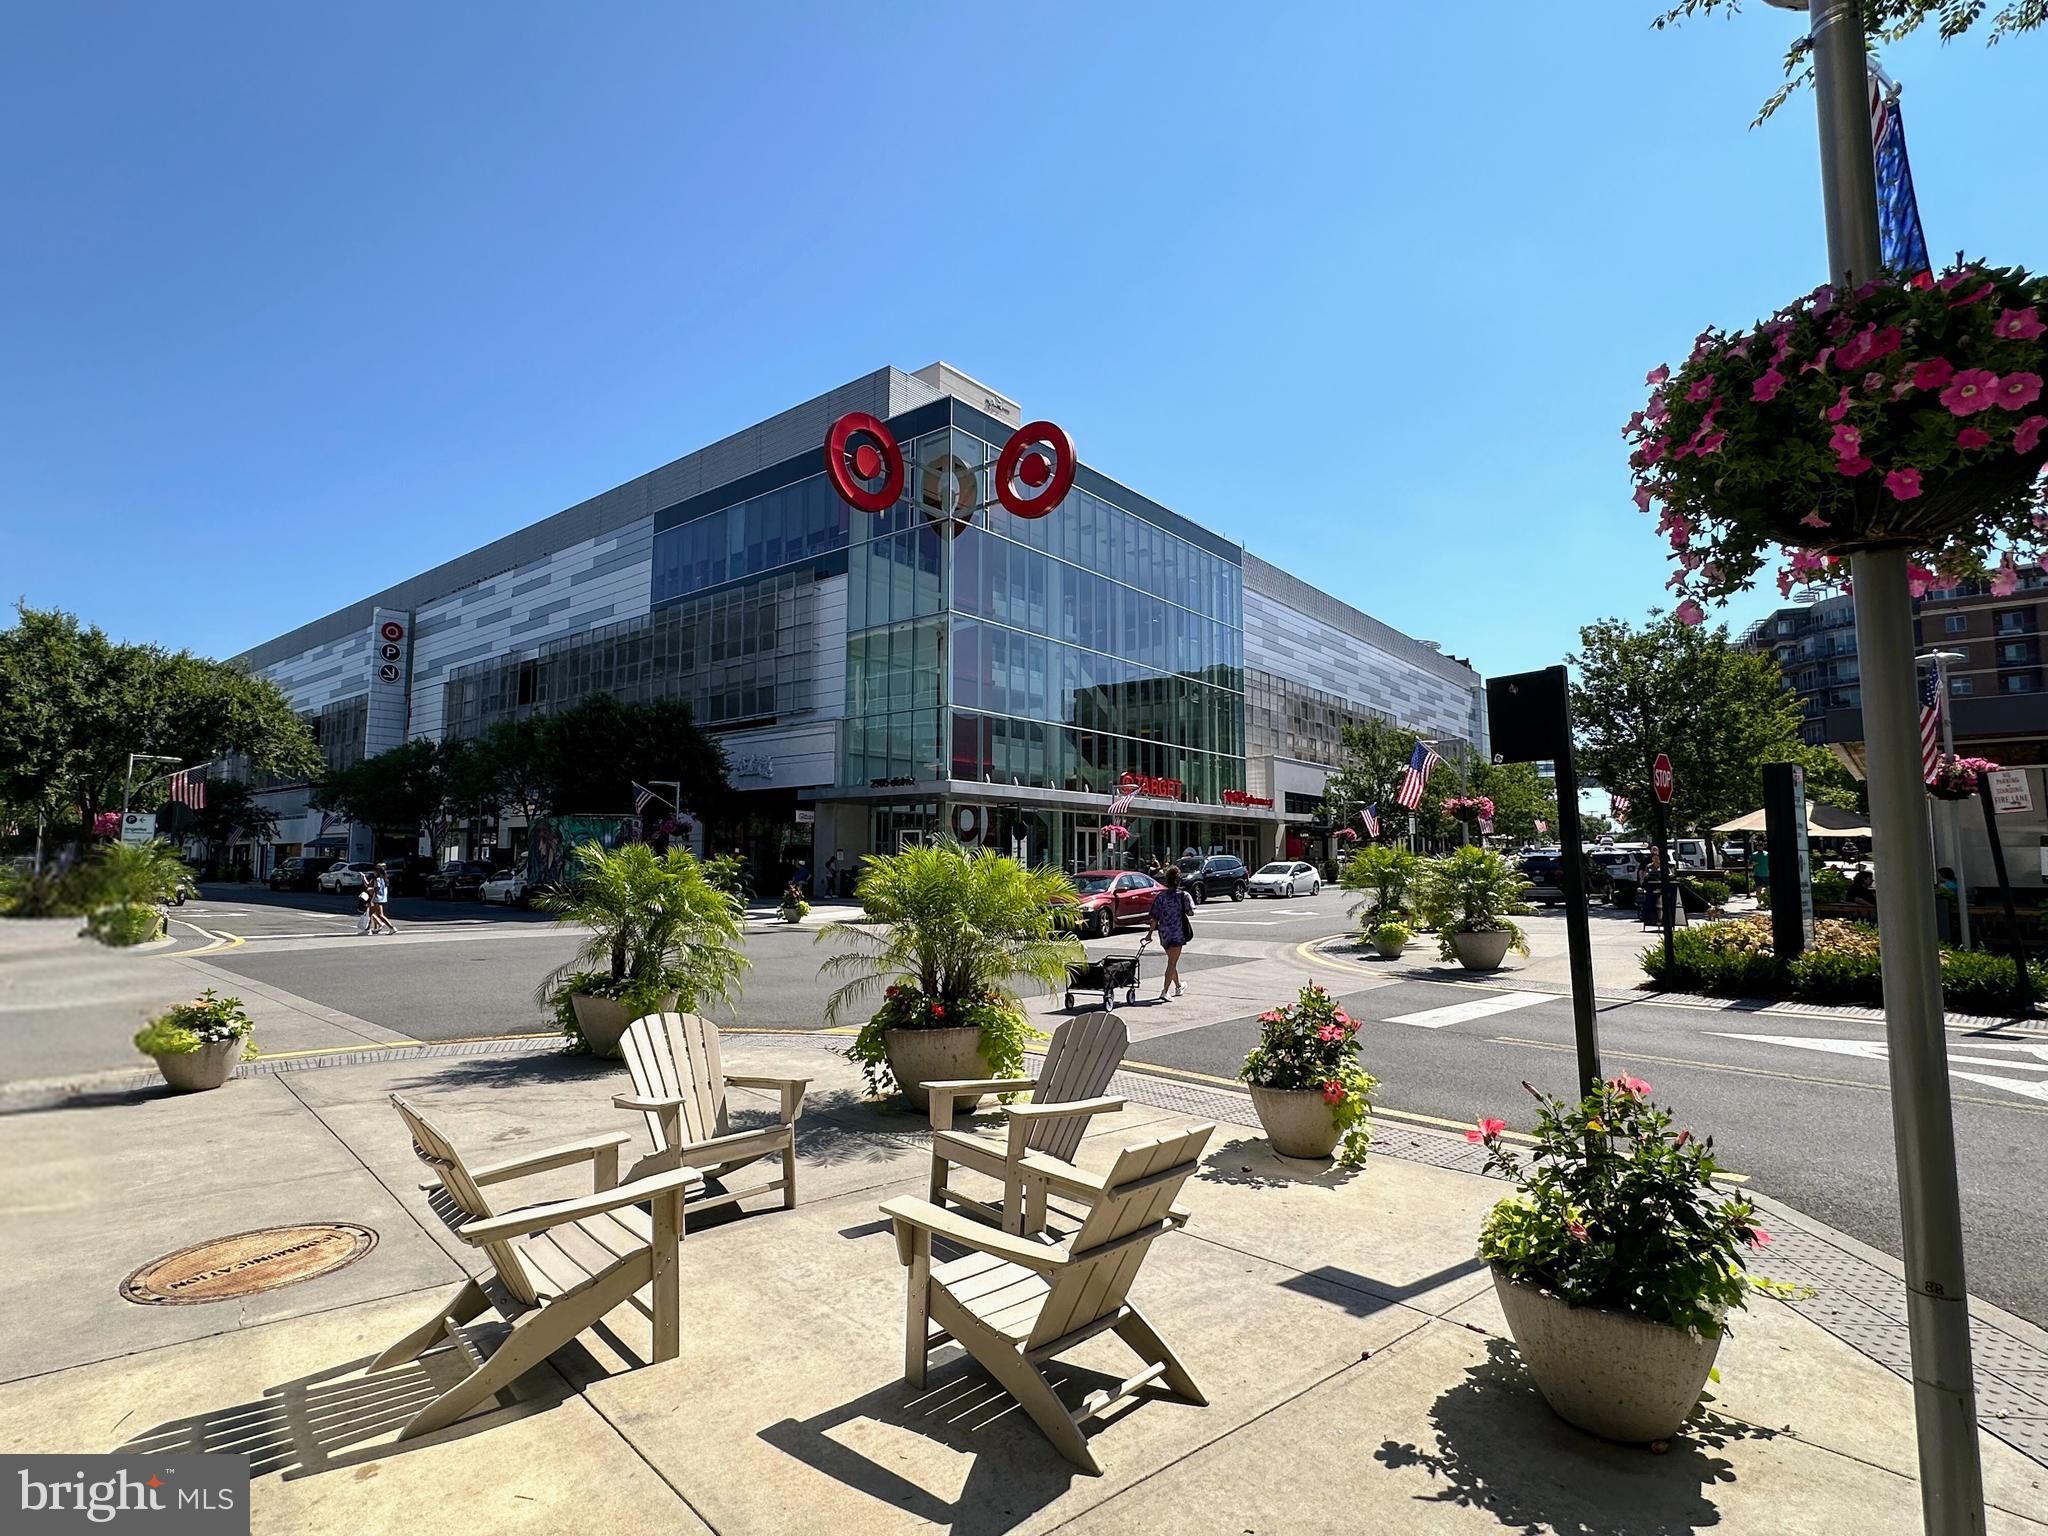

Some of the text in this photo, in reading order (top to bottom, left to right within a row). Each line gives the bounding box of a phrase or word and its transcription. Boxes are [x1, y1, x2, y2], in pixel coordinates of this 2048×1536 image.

[387, 646, 396, 657] P
[1655, 769, 1671, 788] STOP
[1136, 775, 1183, 799] TARGET
[1994, 796, 2009, 804] FIRE
